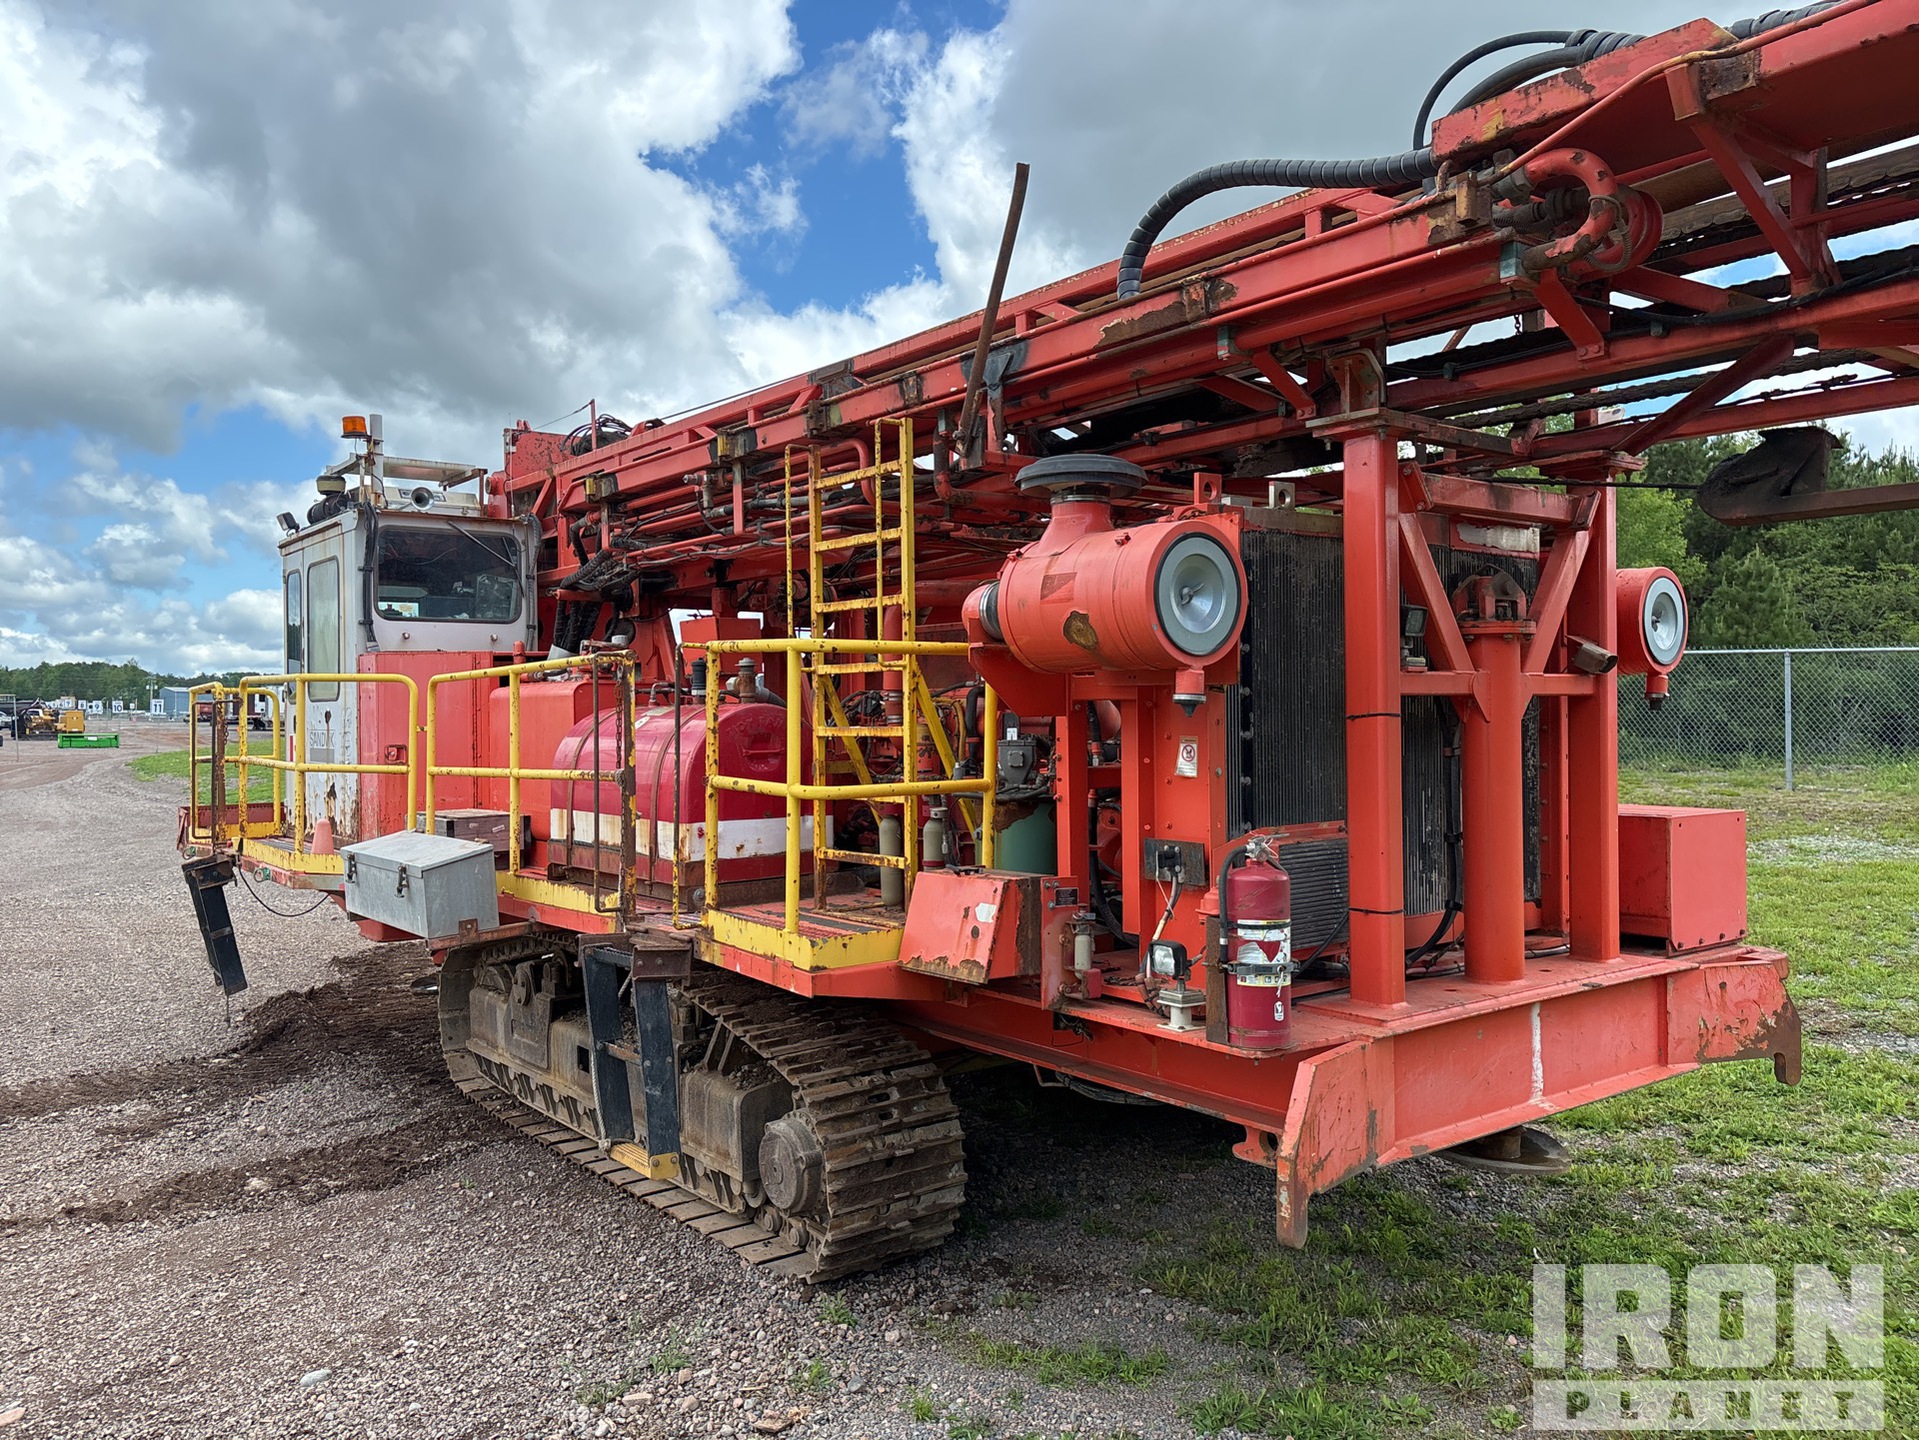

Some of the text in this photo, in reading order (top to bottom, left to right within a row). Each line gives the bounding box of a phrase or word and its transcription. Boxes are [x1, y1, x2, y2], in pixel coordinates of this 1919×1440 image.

[113, 704, 122, 712] 10
[154, 703, 162, 713] 11
[309, 731, 335, 748] SANDK
